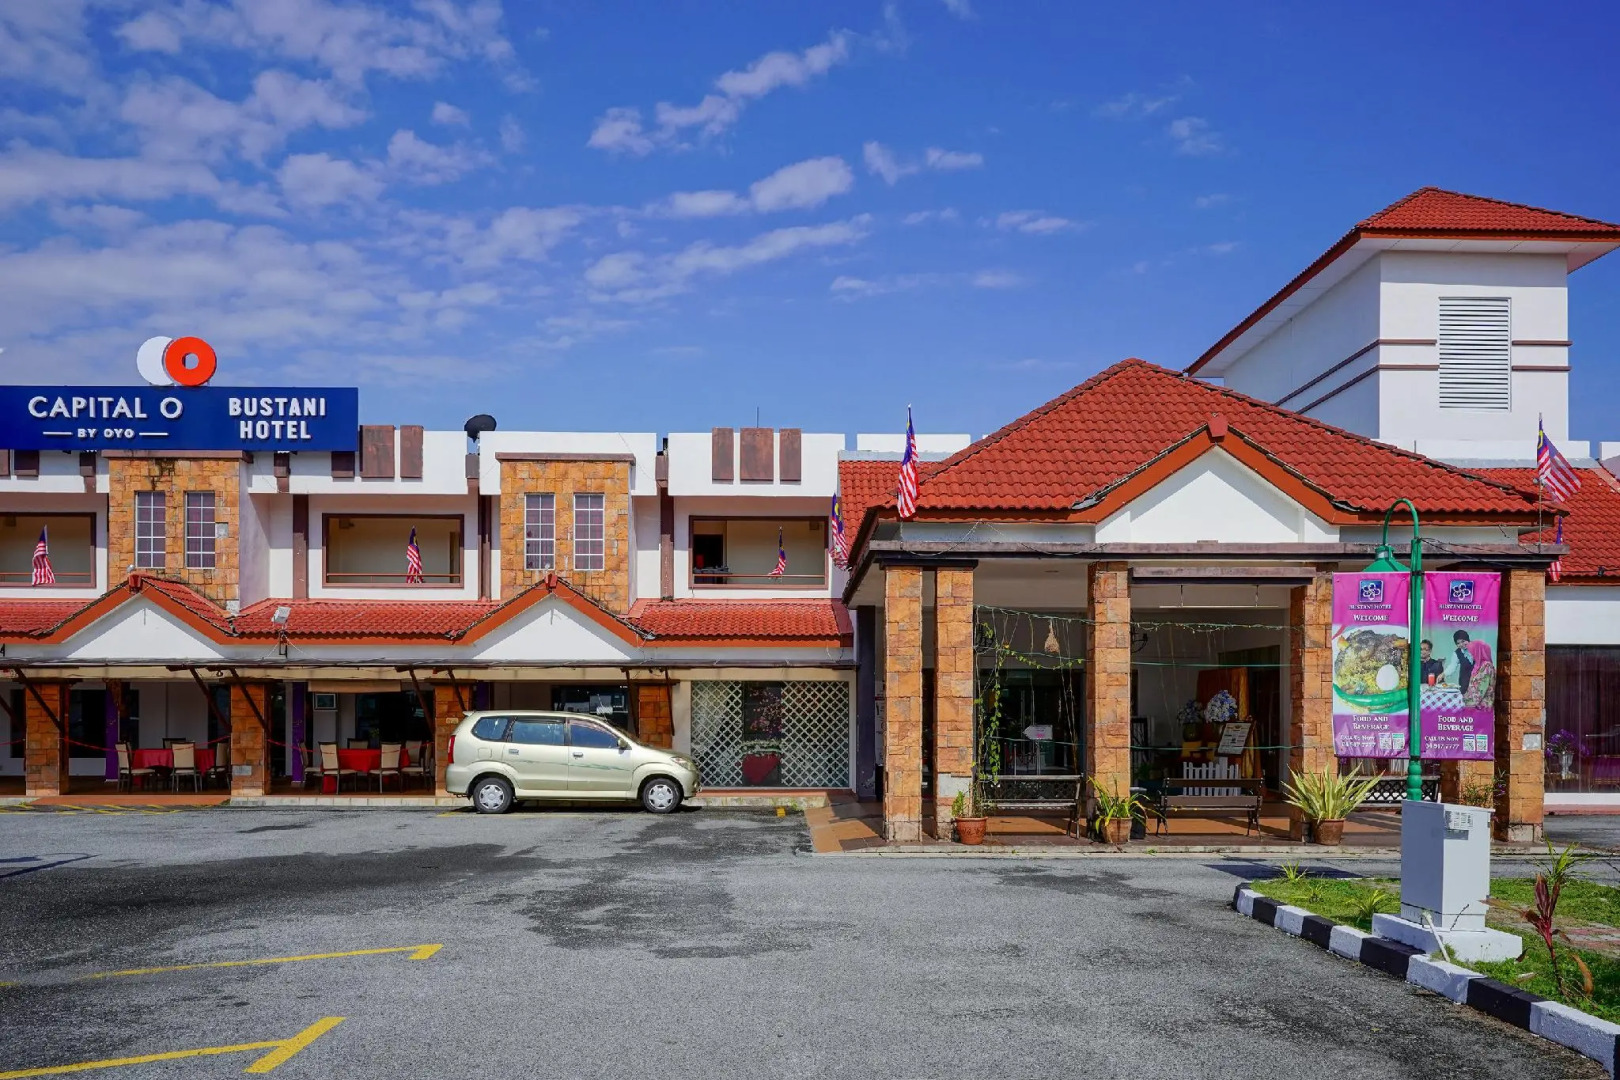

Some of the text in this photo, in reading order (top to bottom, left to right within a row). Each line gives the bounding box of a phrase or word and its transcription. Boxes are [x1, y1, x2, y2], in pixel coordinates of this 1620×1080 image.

[28, 396, 183, 419] CAPITAL O
[229, 397, 326, 416] BUSTANI
[77, 428, 135, 439] BY OYO
[240, 420, 312, 439] HOTEL
[1442, 613, 1478, 622] WELCOME
[1437, 715, 1456, 723] FOOD
[1437, 723, 1474, 731] BEVERAGE
